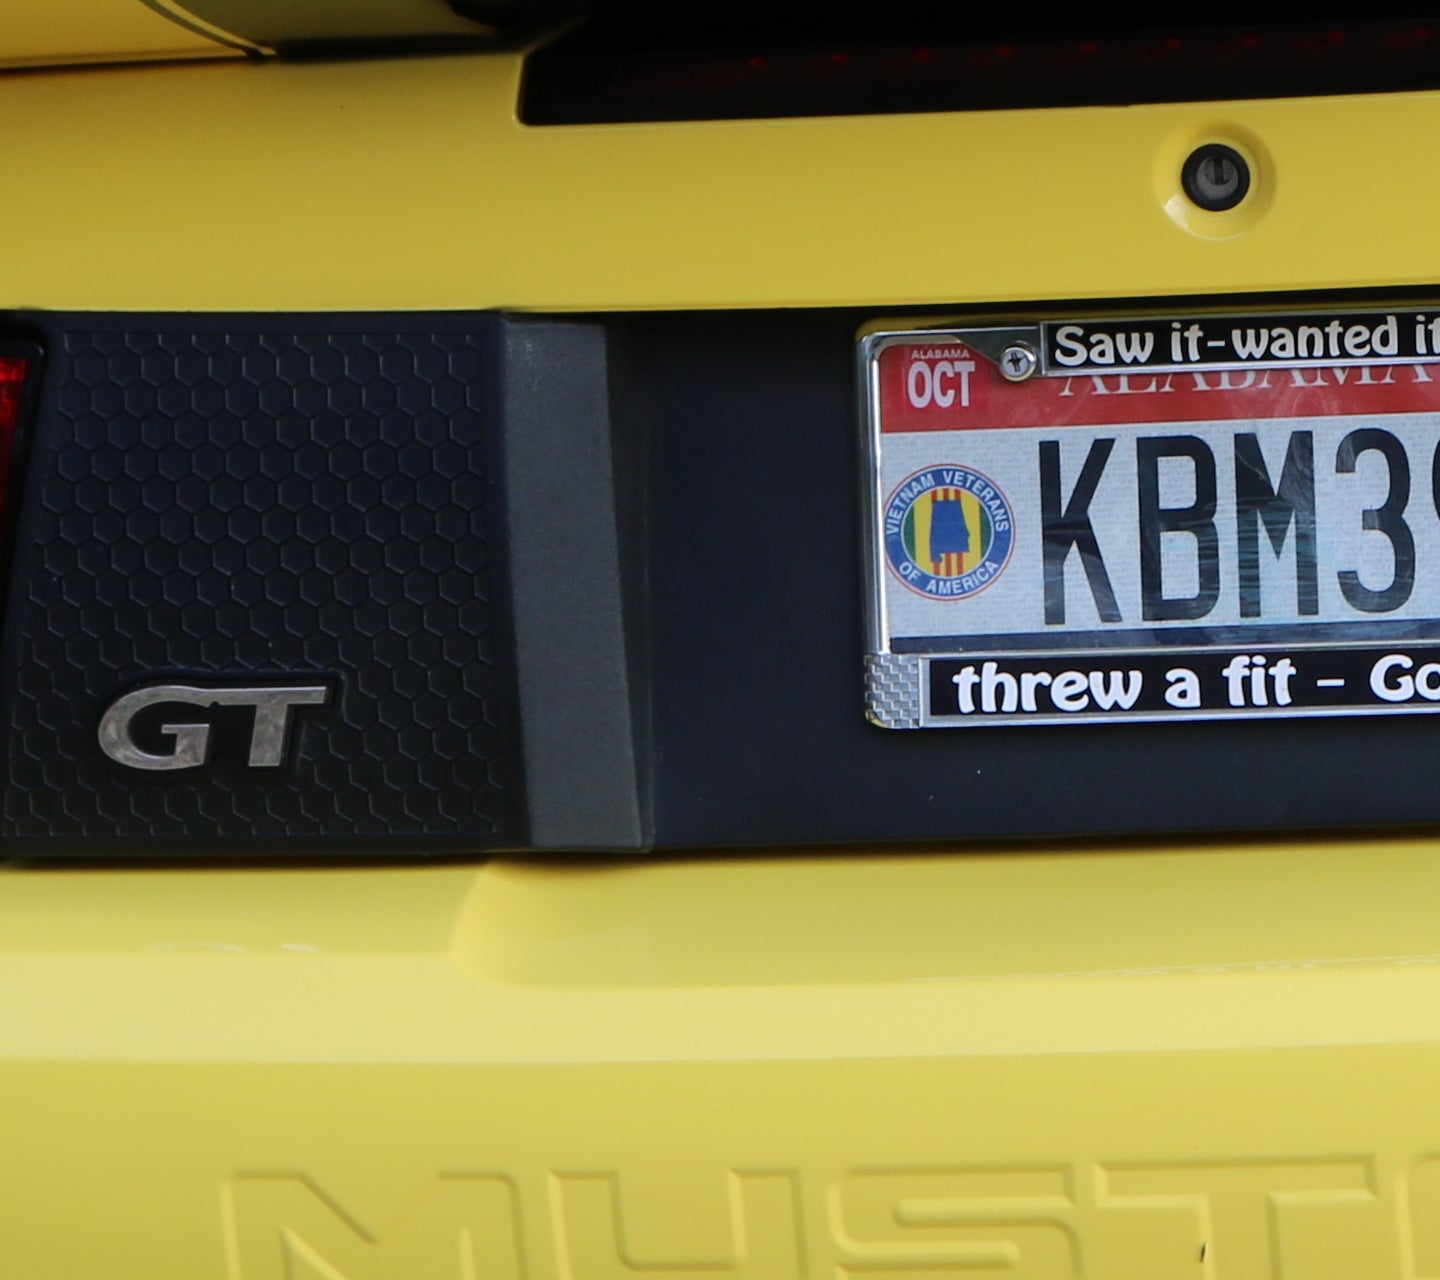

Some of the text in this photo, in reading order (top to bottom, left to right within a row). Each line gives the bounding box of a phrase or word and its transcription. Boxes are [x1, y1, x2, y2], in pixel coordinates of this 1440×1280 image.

[912, 349, 970, 360] ALABAMA
[1054, 322, 1155, 368] Saw
[908, 361, 975, 408] OCT
[886, 470, 1009, 535] VIETNAM VETERANS
[899, 560, 999, 595] OF AMERICA
[953, 661, 1142, 713] threw
[1166, 668, 1200, 708] a
[1222, 655, 1297, 707] fit
[98, 685, 327, 770] GT
